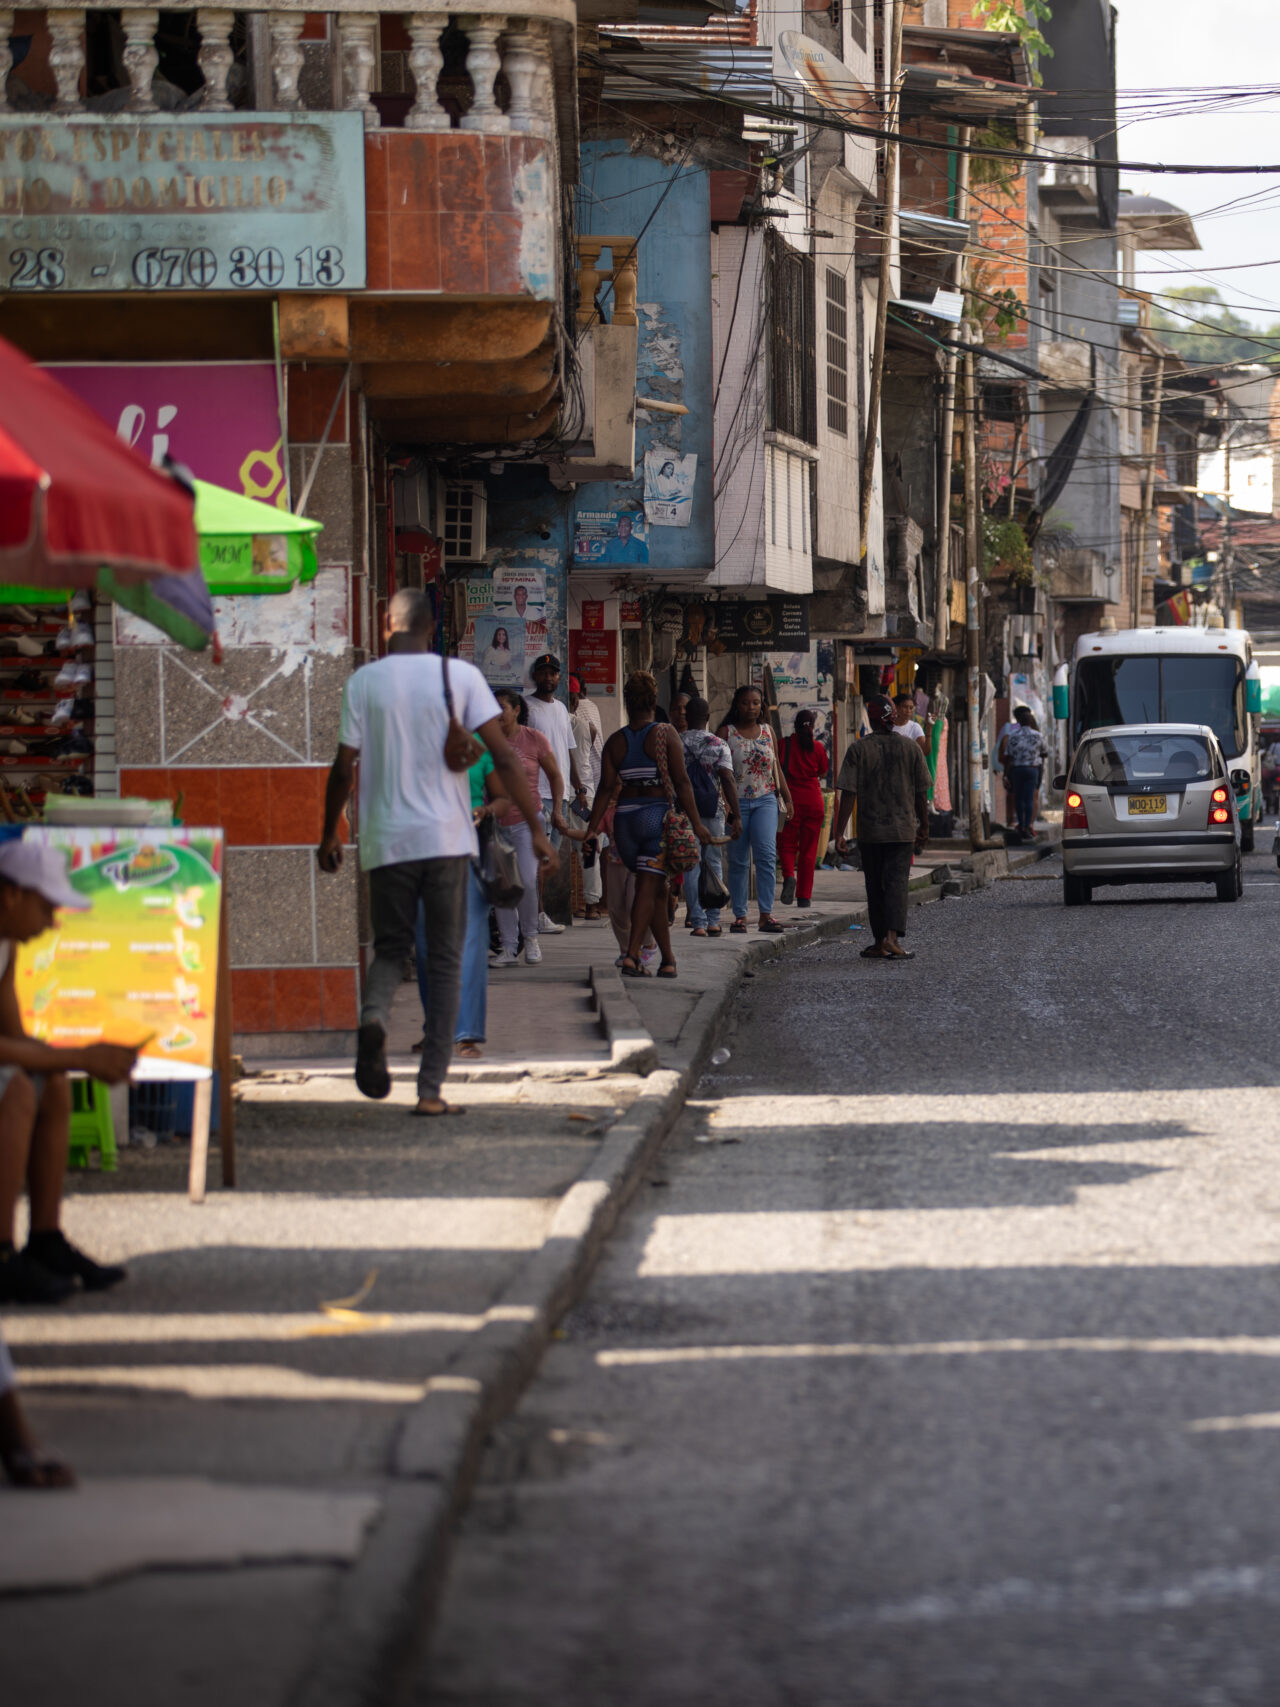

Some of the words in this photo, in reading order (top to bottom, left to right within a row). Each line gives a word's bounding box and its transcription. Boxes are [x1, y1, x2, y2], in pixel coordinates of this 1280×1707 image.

[72, 130, 266, 163] ESPECIALES
[104, 175, 288, 209] DOMICILIO
[577, 510, 618, 519] Armando
